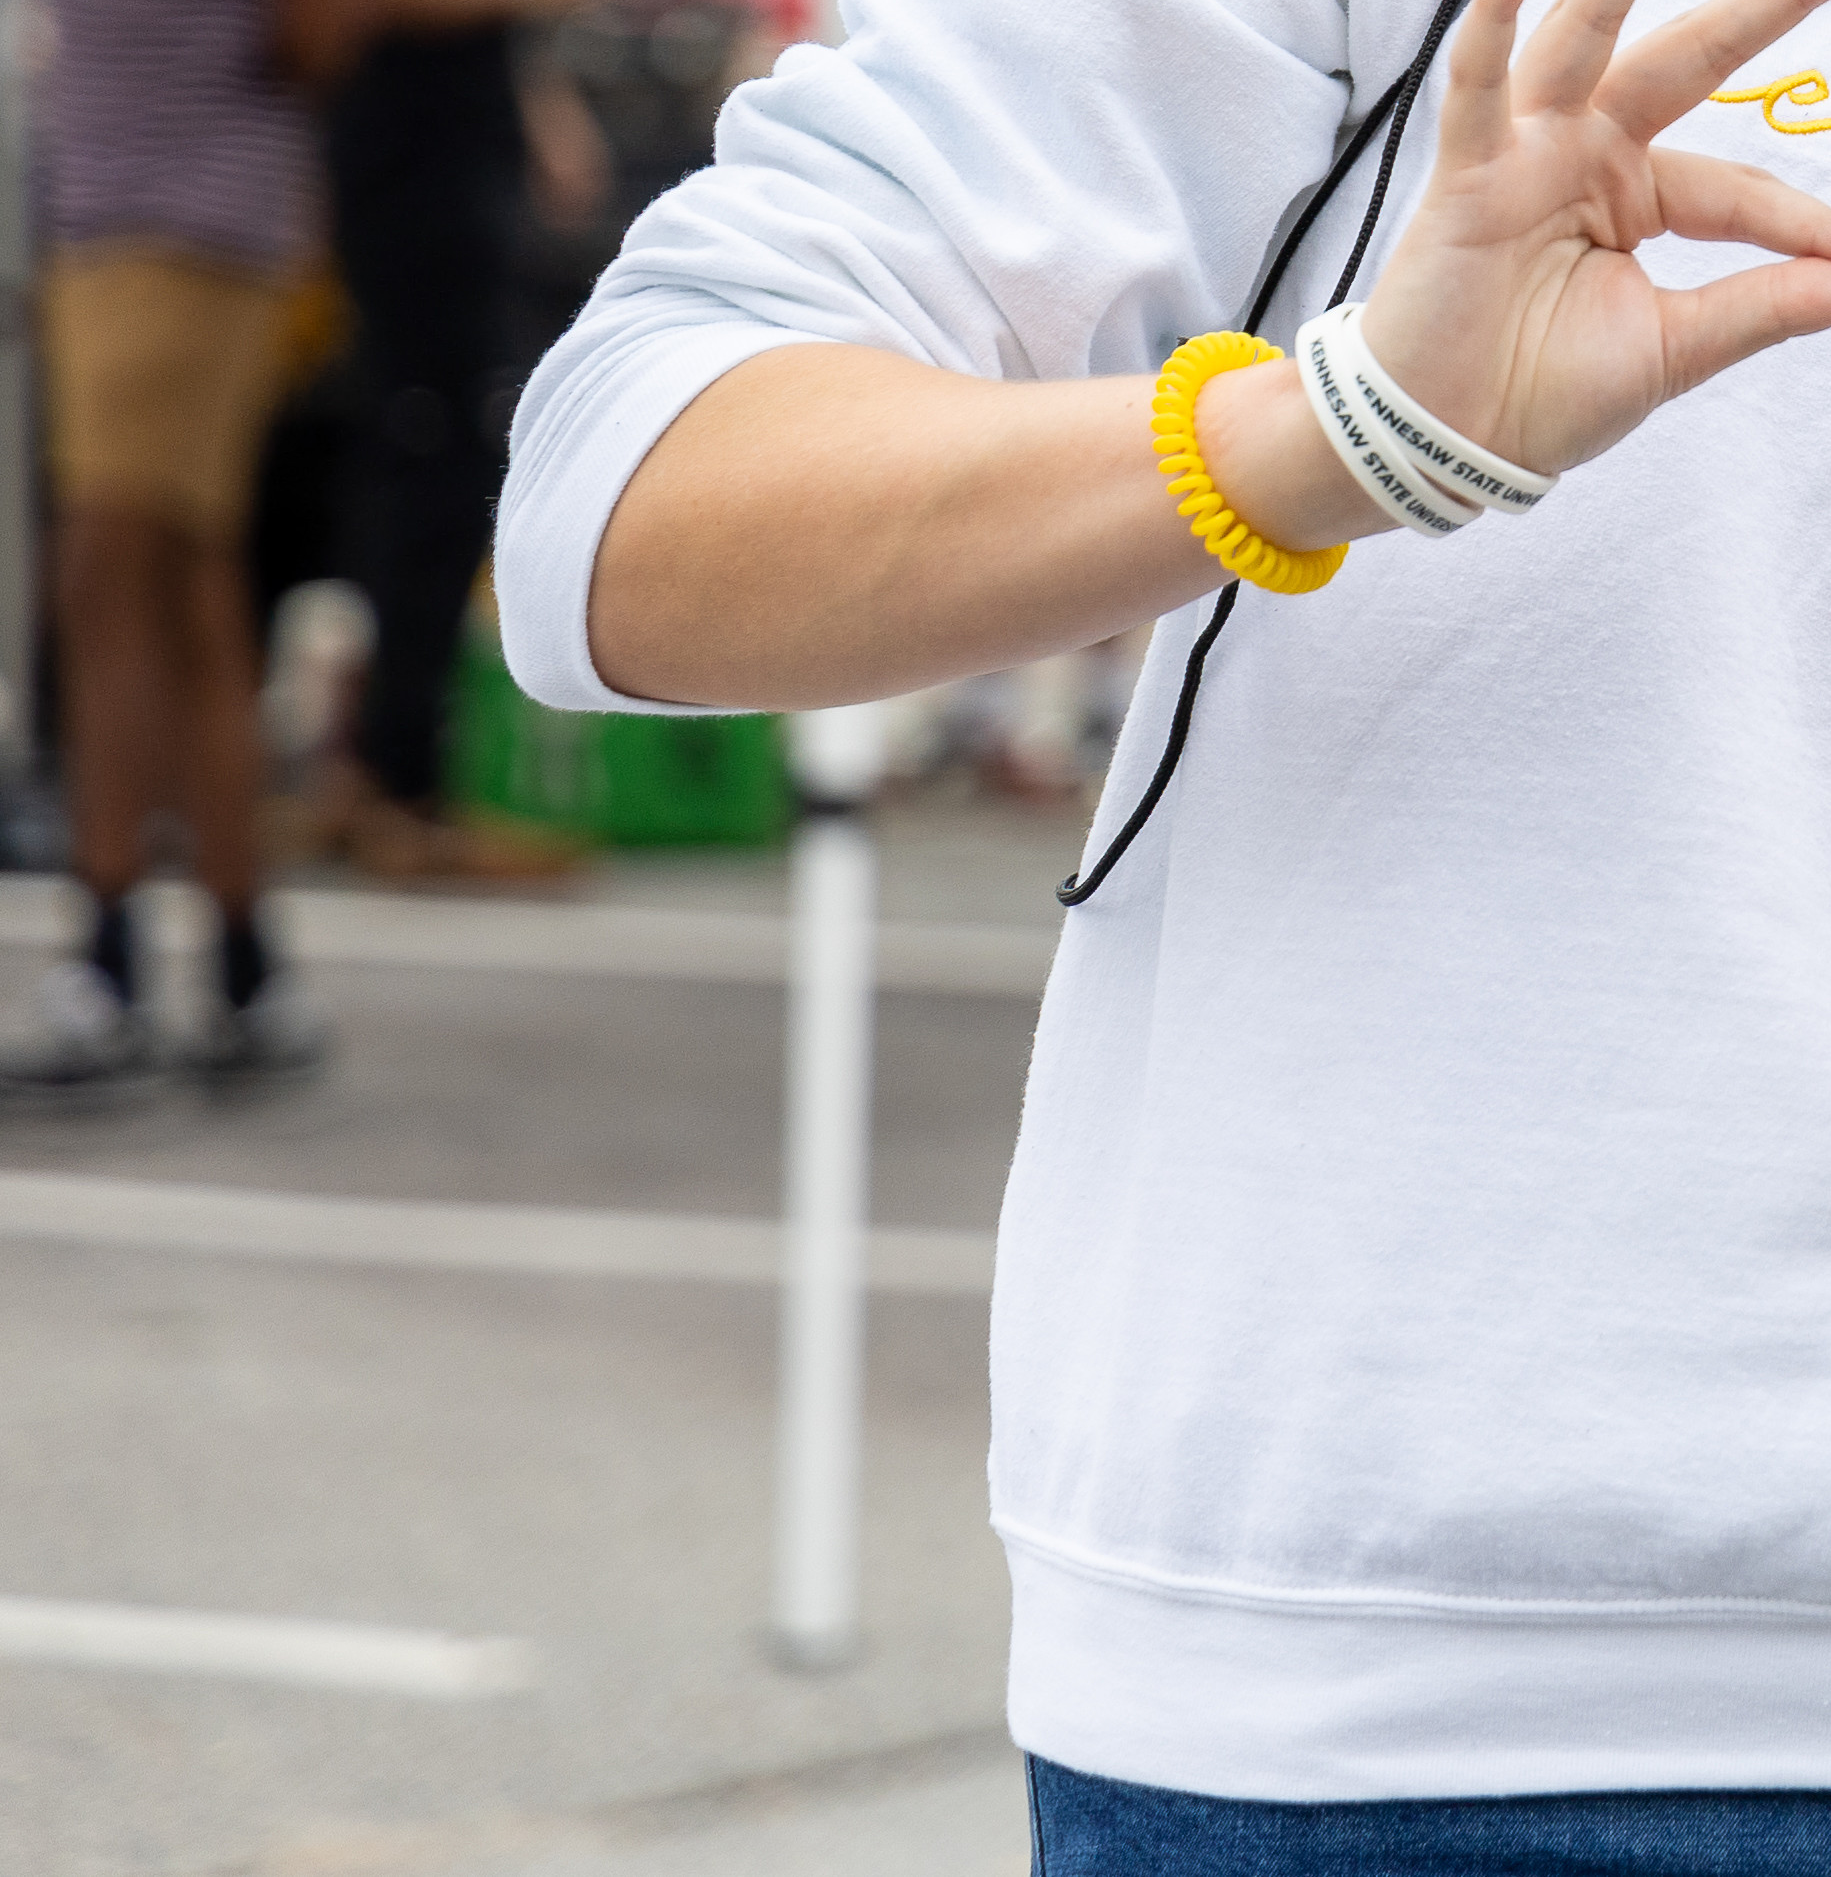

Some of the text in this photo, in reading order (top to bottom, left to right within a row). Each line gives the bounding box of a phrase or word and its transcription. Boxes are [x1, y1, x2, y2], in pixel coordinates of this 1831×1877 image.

[1310, 336, 1370, 448] KENNESAW
[1363, 451, 1412, 503] STATE
[1452, 461, 1505, 495] STATE
